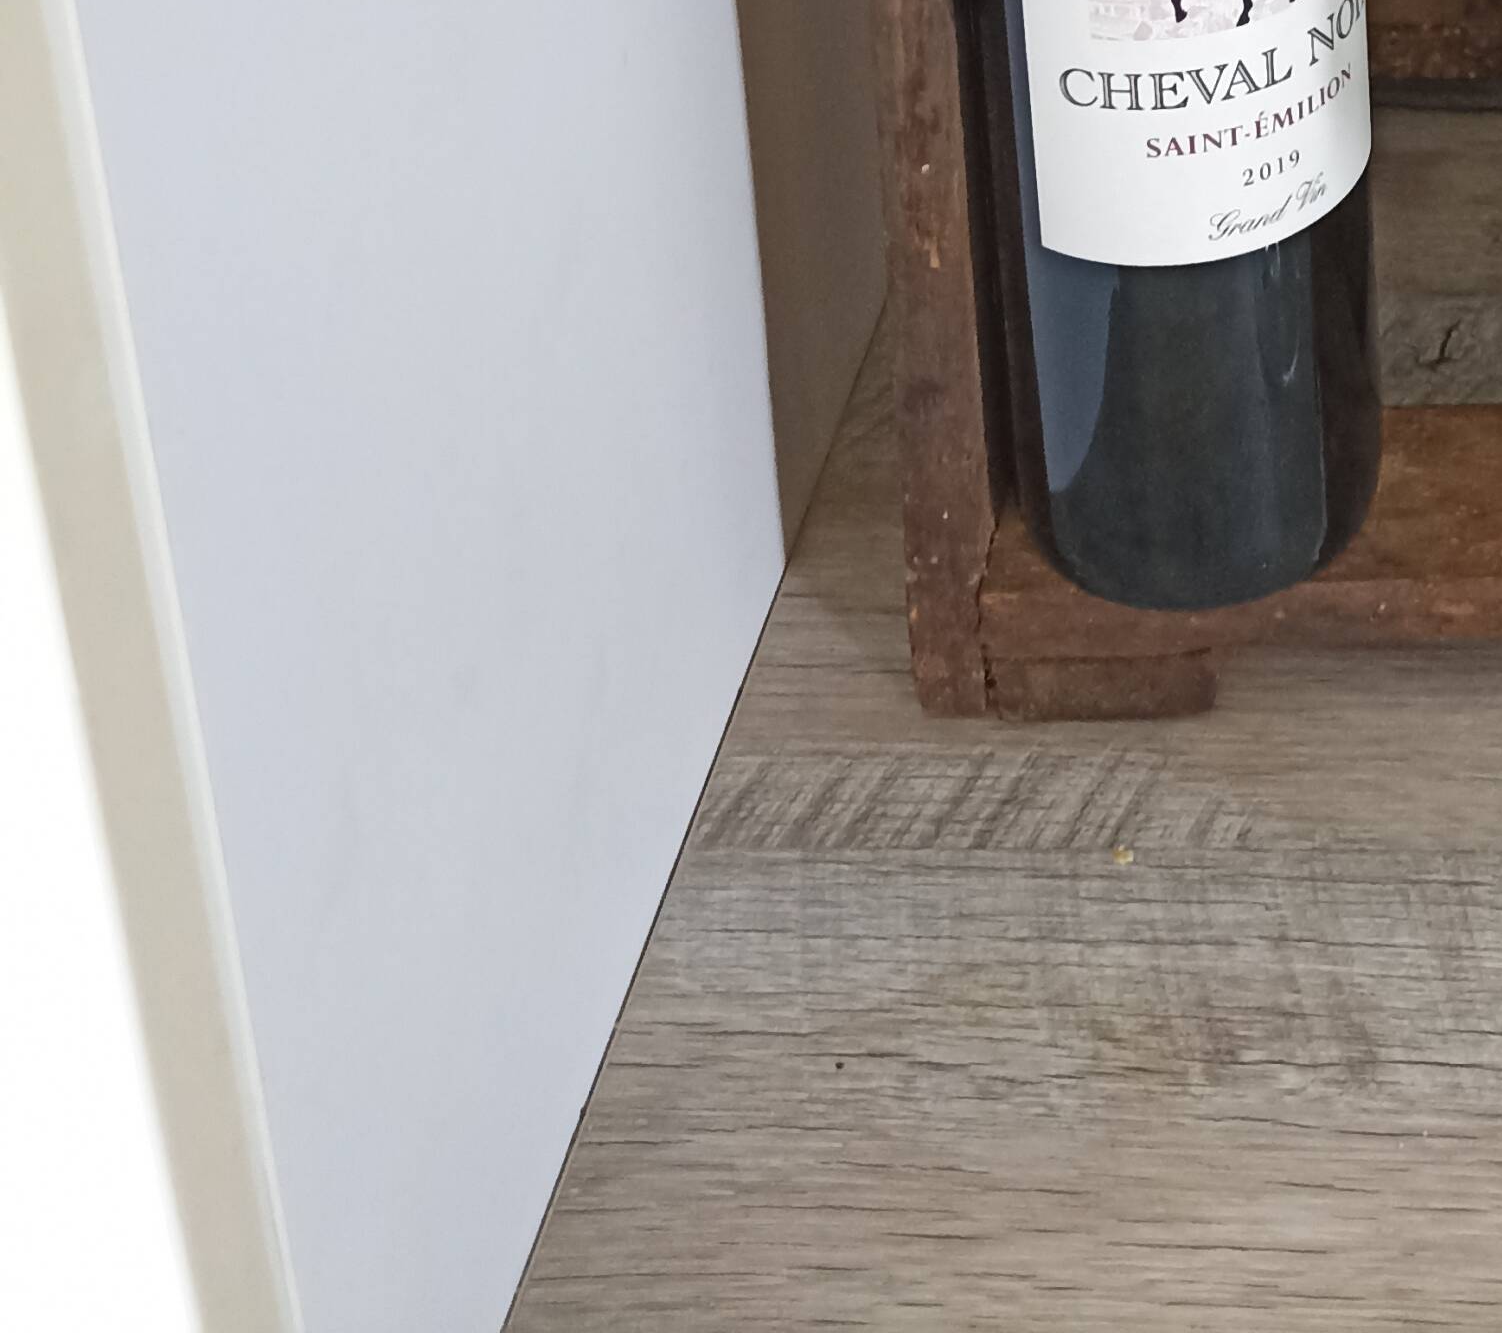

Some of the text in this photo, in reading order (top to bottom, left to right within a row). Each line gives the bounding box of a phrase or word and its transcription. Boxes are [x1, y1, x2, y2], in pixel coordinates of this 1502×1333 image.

[1058, 47, 1293, 110] CHEVAL
[1146, 62, 1352, 158] SAINT-ÉMILION
[1242, 149, 1300, 186] 2019
[1208, 171, 1327, 240] Grand Vin
